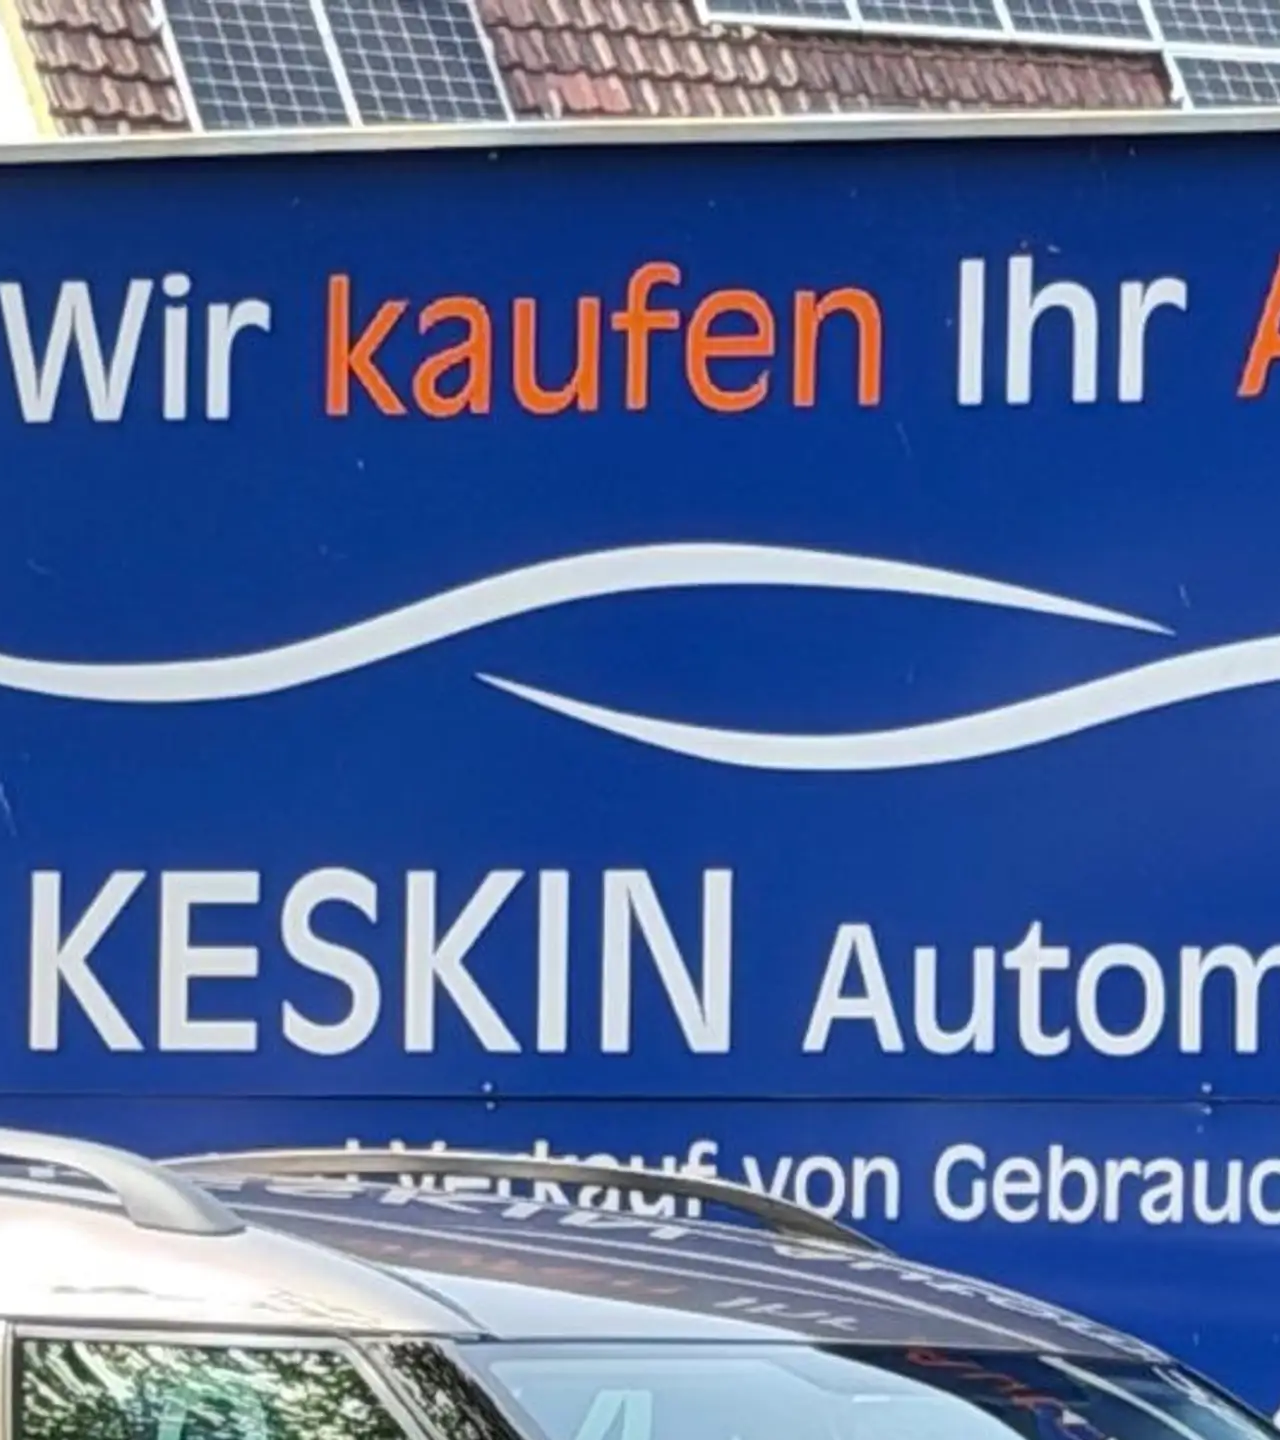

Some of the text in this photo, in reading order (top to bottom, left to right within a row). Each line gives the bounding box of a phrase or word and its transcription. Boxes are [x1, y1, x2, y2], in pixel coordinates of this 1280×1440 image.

[326, 262, 882, 417] kaufen
[958, 255, 1187, 405] Ihr
[29, 867, 732, 1055] KESKIN
[741, 1155, 900, 1221] von
